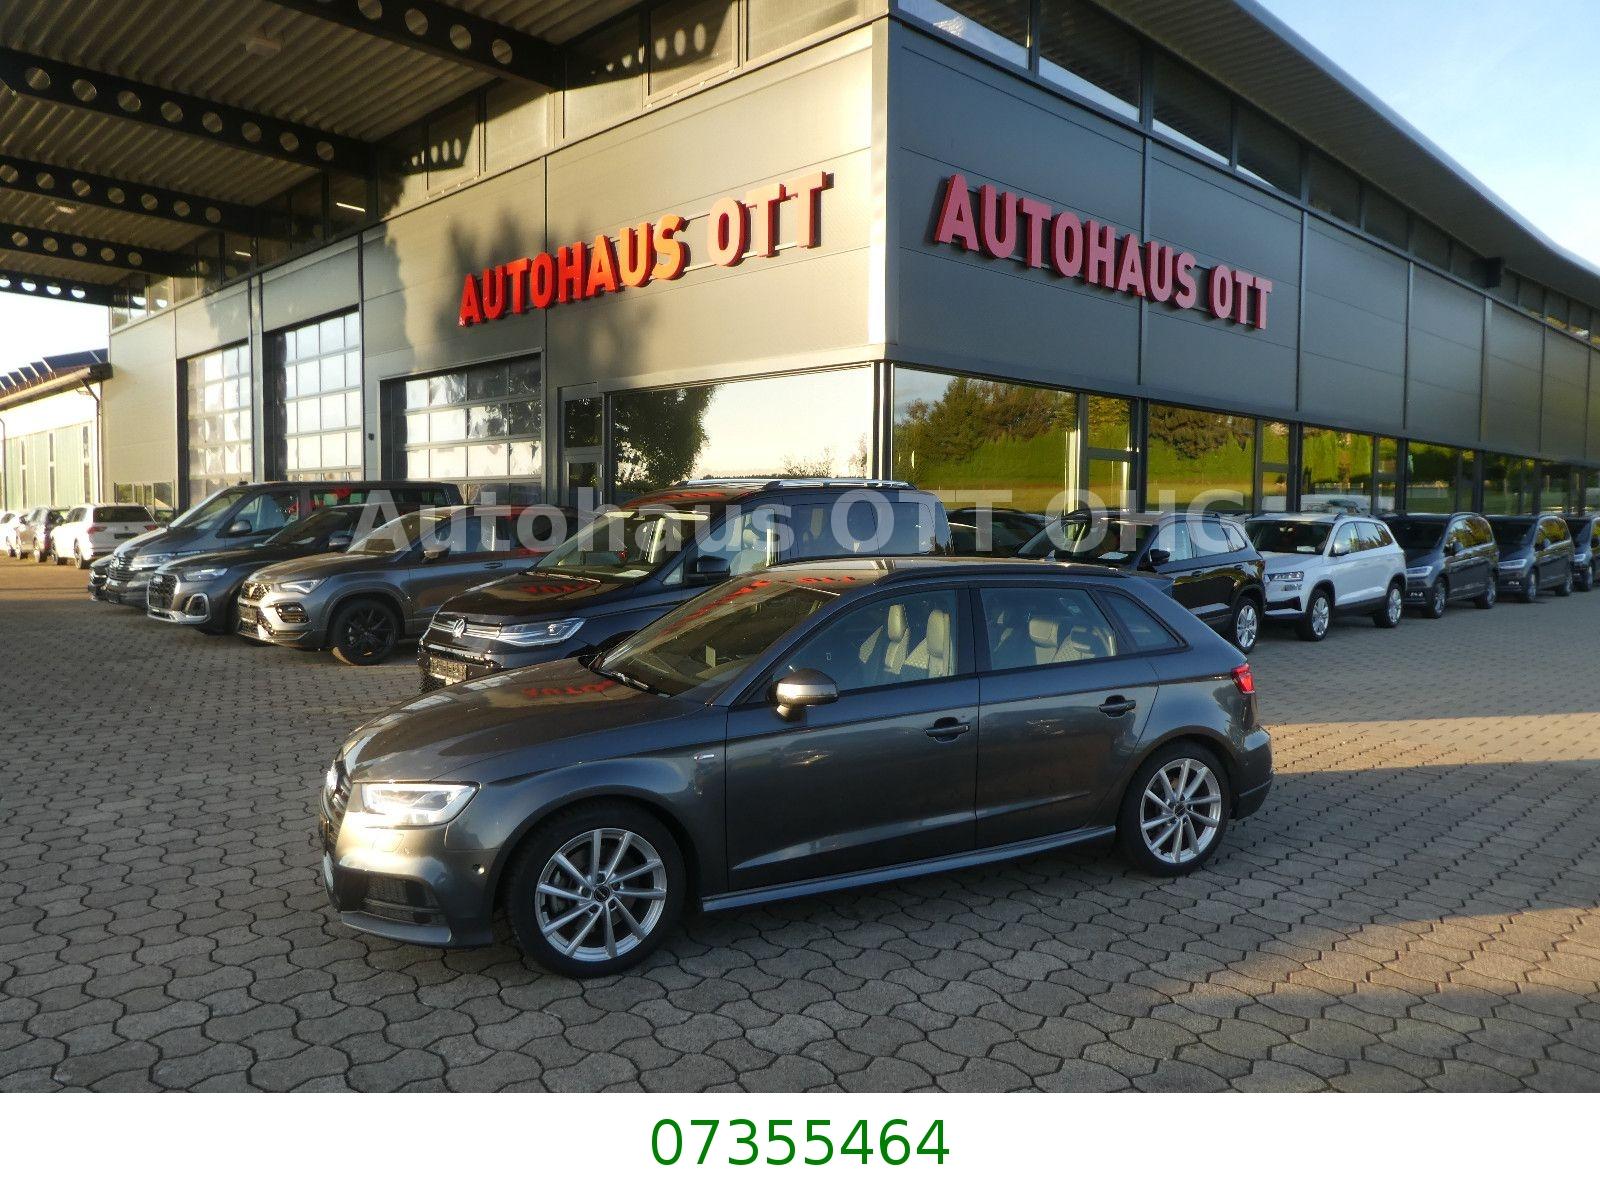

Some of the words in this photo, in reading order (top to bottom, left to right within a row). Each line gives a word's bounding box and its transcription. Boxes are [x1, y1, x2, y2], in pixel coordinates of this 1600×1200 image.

[458, 214, 690, 327] AUTOHAUS
[707, 171, 833, 267] OTT
[934, 173, 1197, 309] AUTOHAUS
[1208, 264, 1272, 330] OTT
